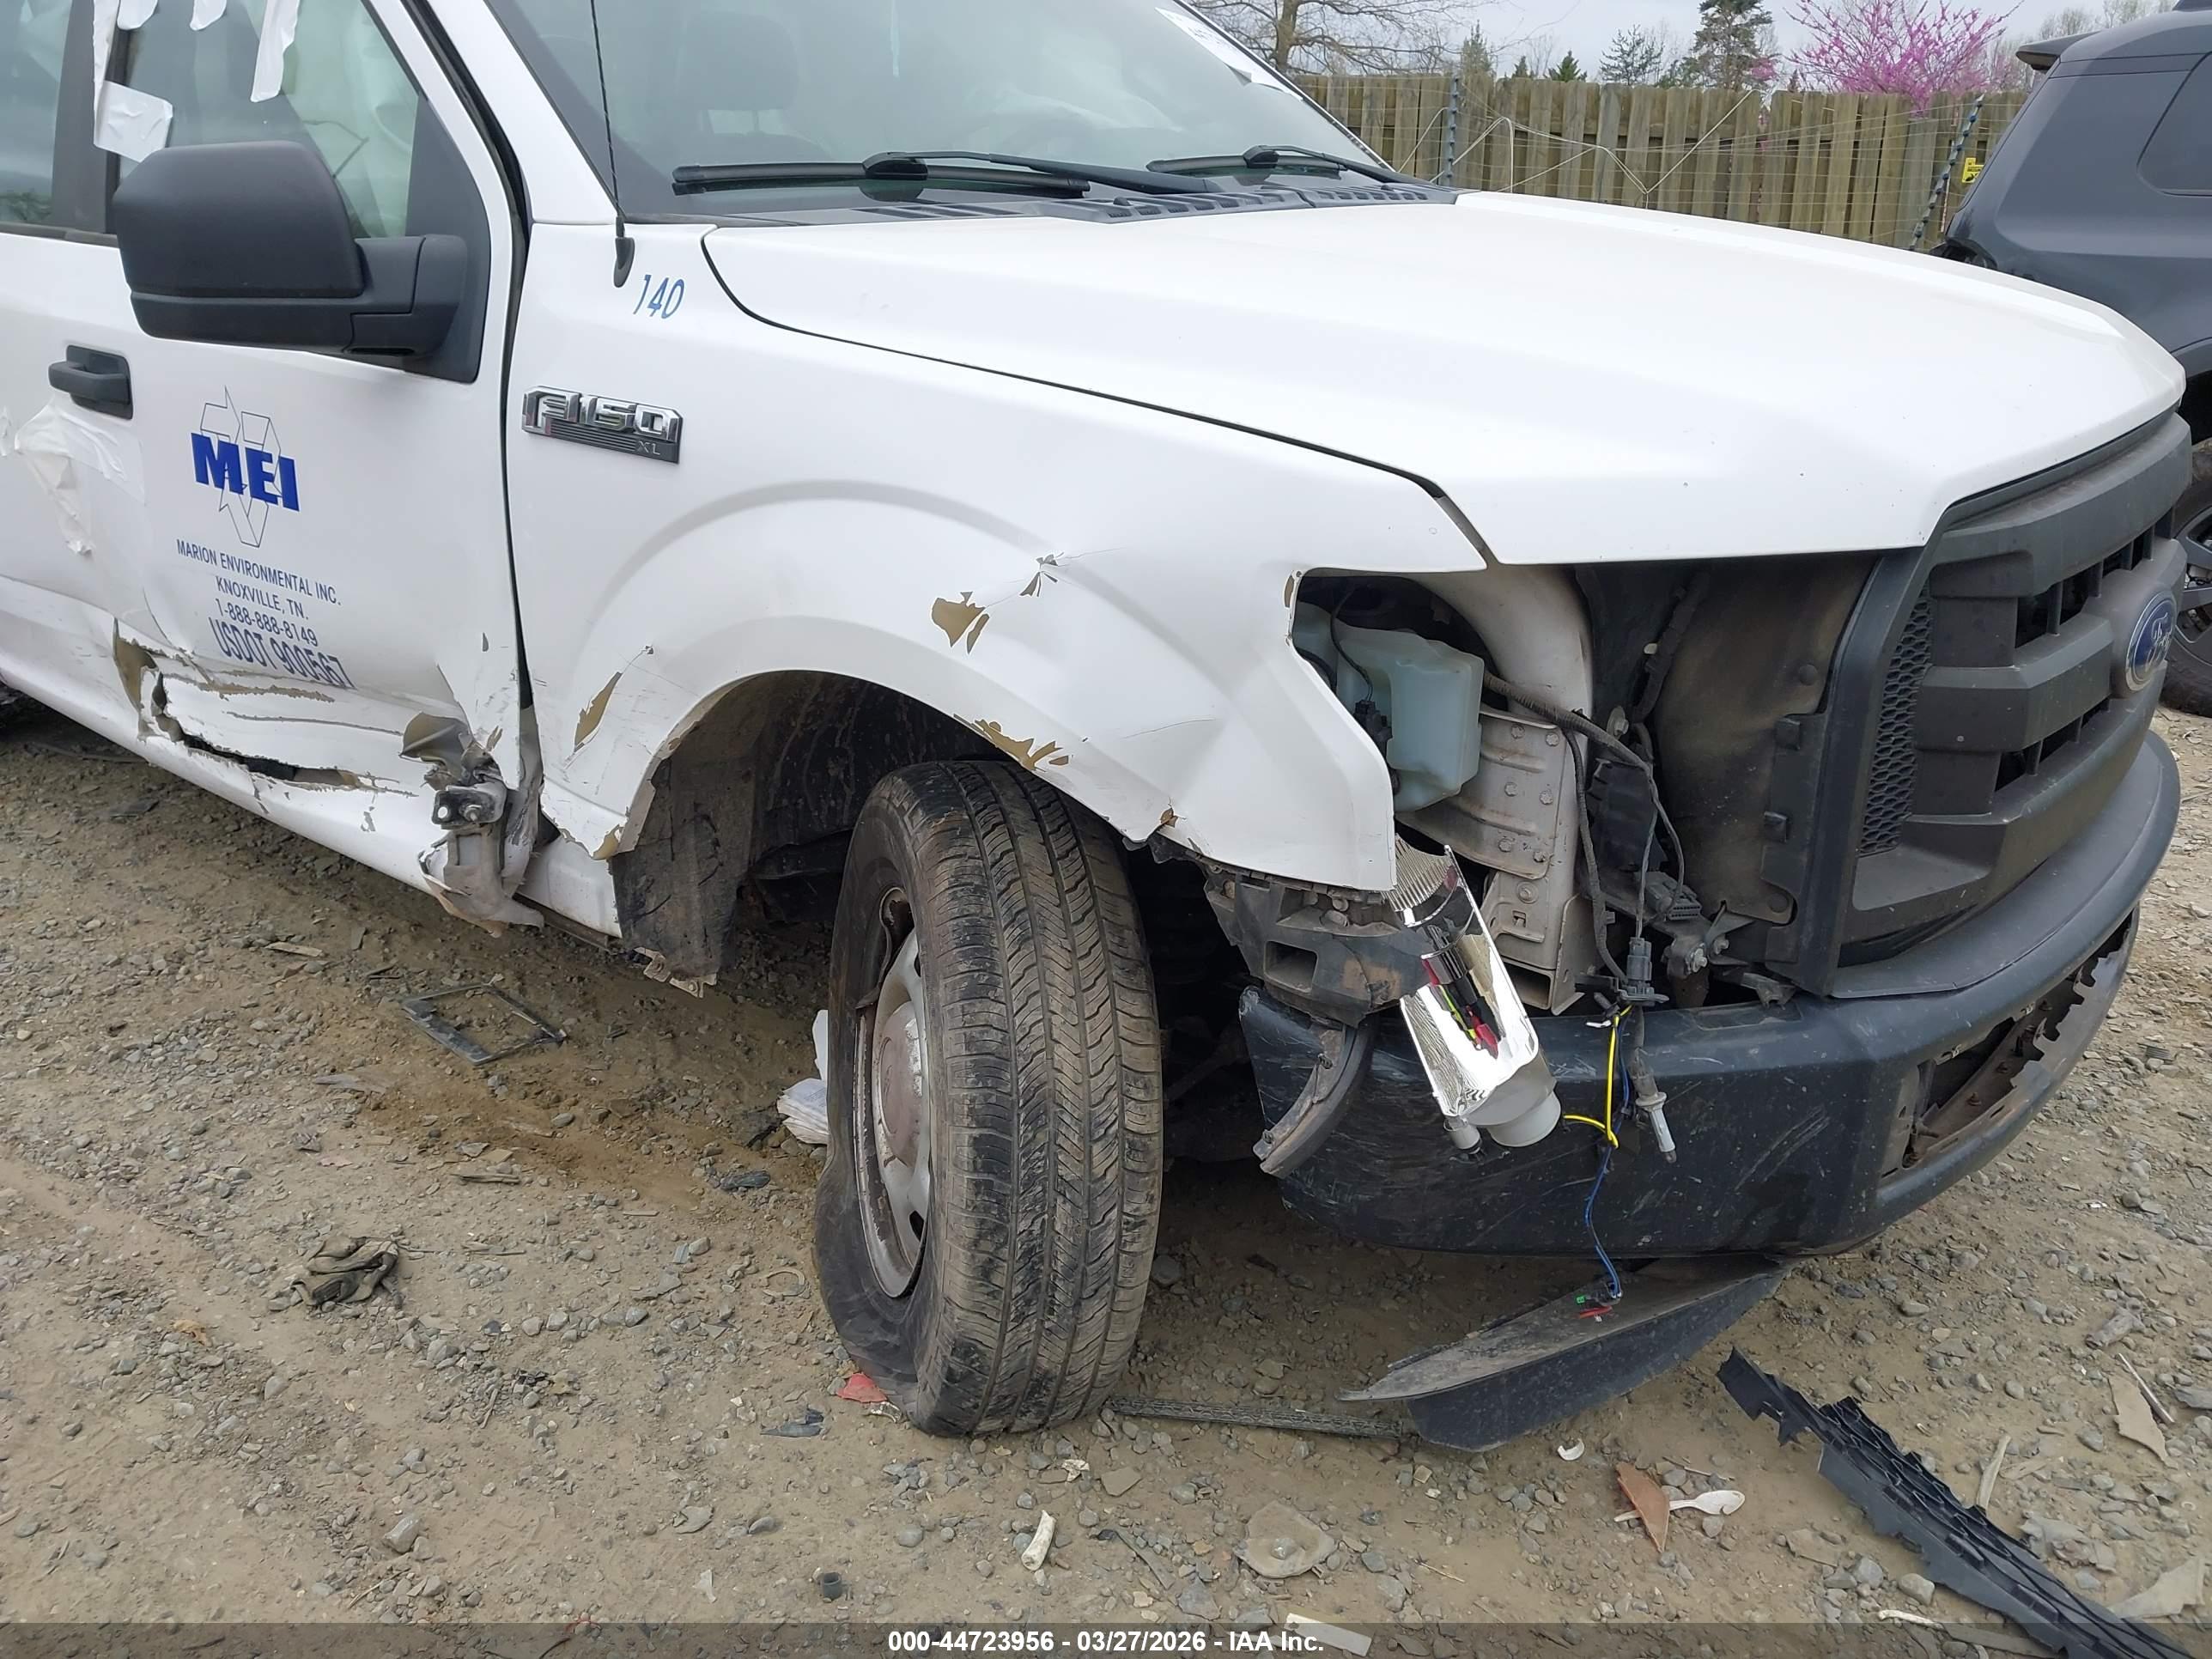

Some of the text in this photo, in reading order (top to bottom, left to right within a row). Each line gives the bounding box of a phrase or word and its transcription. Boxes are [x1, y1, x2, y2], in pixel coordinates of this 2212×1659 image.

[633, 274, 684, 319] 140
[637, 439, 660, 456] XL
[191, 432, 300, 512] MEI
[176, 538, 342, 606] MARION ENVIRONMENTAL INC.
[216, 575, 309, 620] KNOXVILLE, TN.
[216, 599, 318, 647] 1-888-888-8149
[209, 617, 356, 690] USDOT 900567
